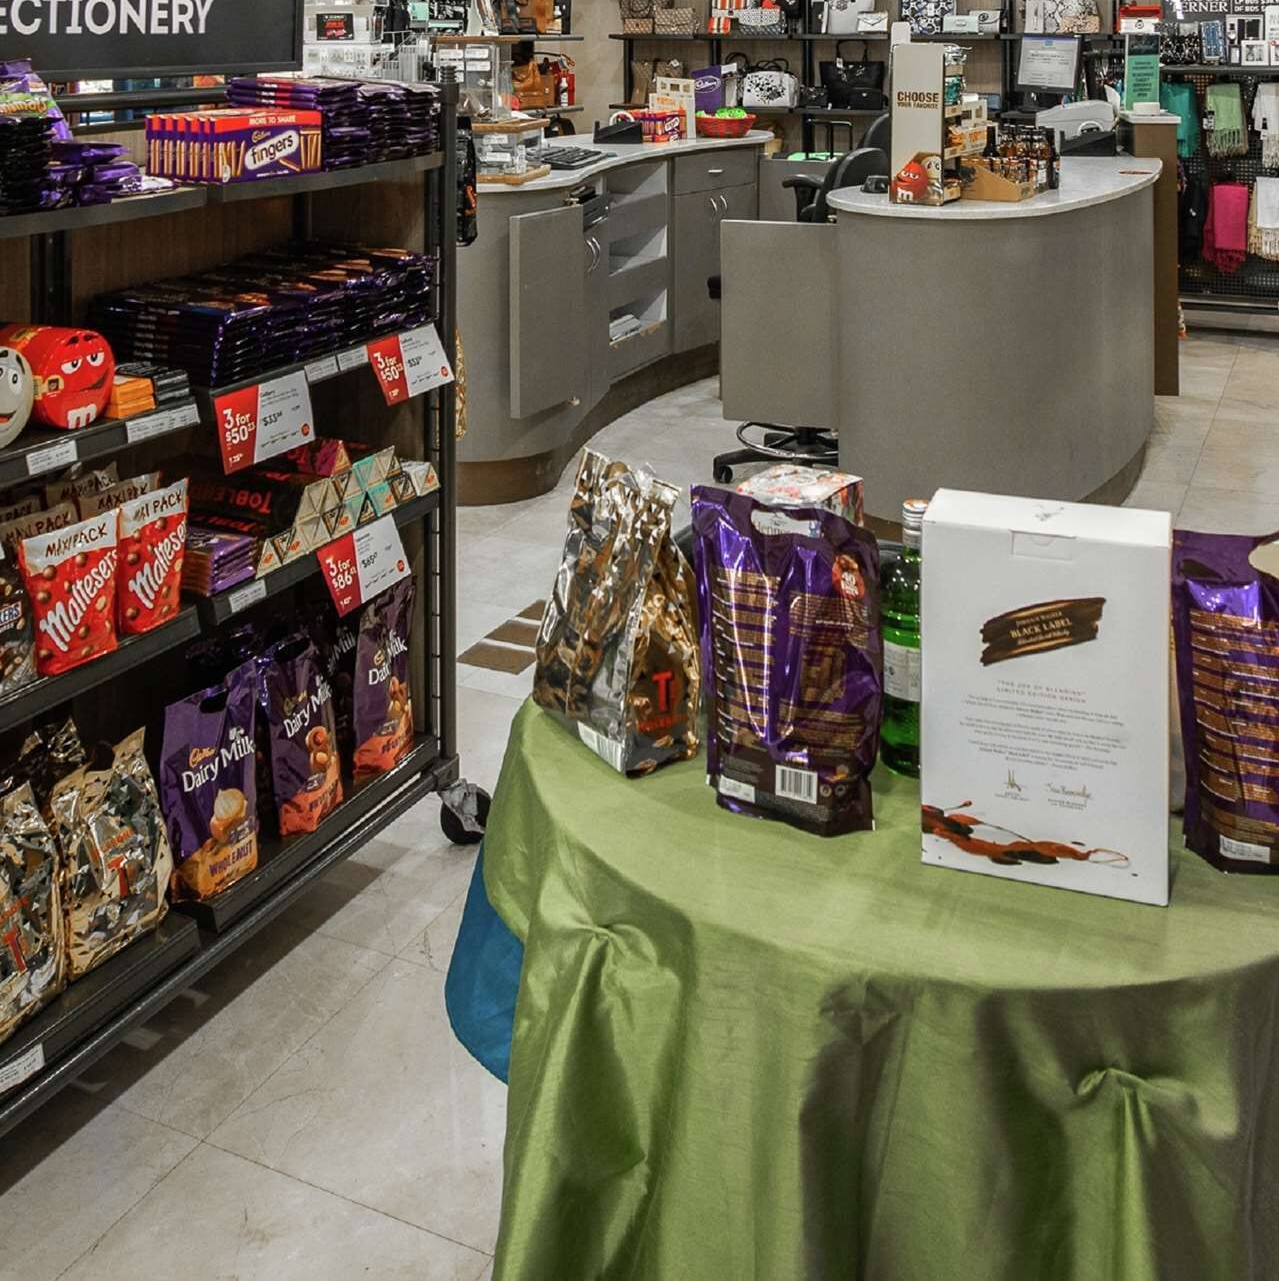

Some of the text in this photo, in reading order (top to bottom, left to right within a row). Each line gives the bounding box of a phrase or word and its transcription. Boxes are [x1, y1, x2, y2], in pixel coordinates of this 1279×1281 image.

[897, 91, 939, 103] CHOOSE
[249, 117, 267, 125] MORE
[277, 115, 296, 123] SHARE
[251, 134, 294, 165] fingers
[374, 352, 397, 368] 3 for
[223, 408, 251, 429] 3 for
[153, 490, 183, 513] PACK
[36, 511, 69, 532] PACK
[70, 523, 107, 548] PACK
[326, 556, 351, 577] 3 for
[40, 550, 117, 652] Maltesers
[1009, 619, 1073, 639] BLACK LABEL
[284, 682, 332, 739] Dairy Milk
[182, 734, 256, 793] Dairy Milk
